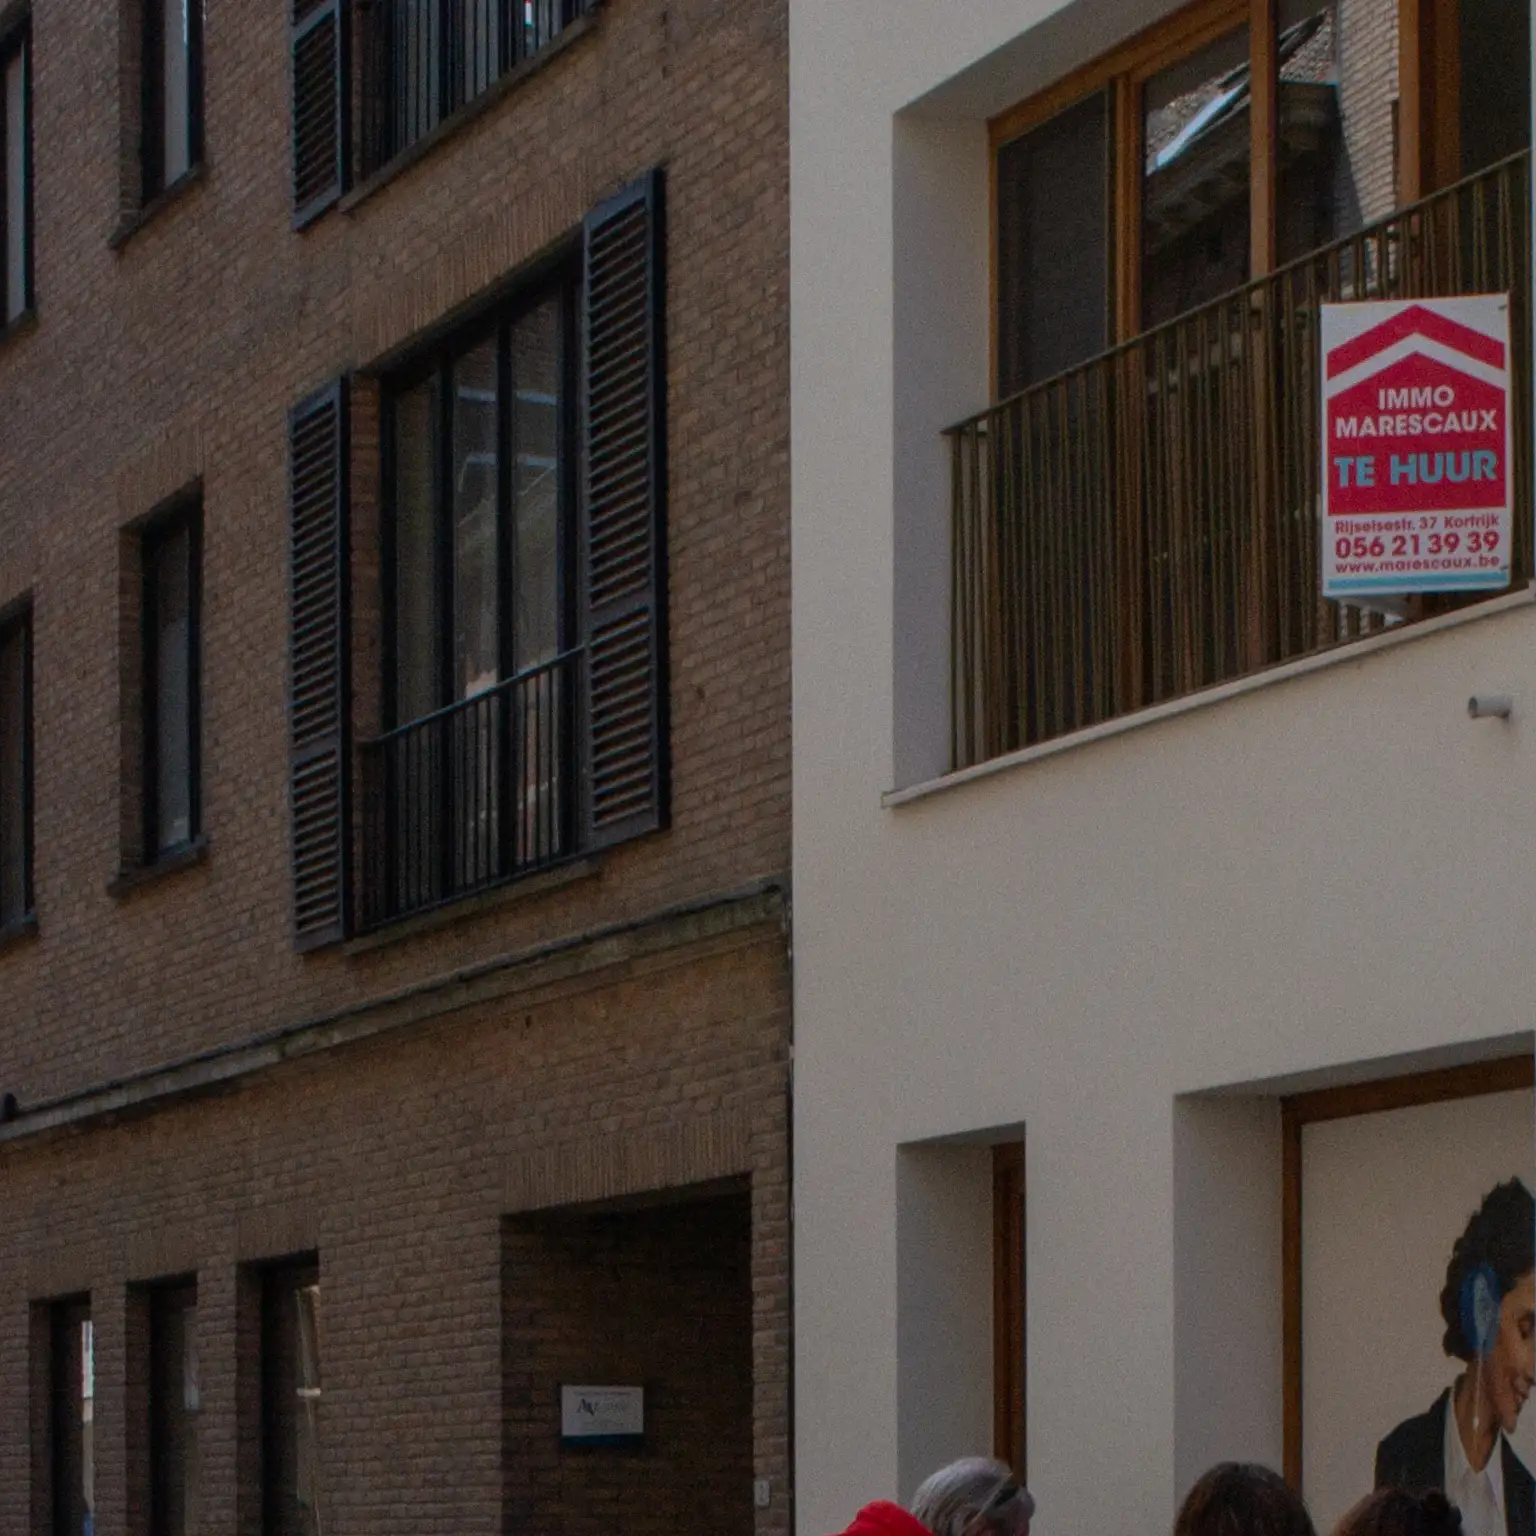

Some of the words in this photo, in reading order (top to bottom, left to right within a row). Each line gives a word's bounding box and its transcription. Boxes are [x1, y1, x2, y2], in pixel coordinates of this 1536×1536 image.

[1379, 385, 1455, 411] IMMO
[1335, 408, 1497, 439] MARESCAUX
[1333, 456, 1376, 488] TE
[1390, 450, 1498, 486] HUUR
[1419, 517, 1438, 530] 37
[1444, 514, 1500, 530] Kortrijk
[1335, 536, 1385, 558] 056
[1392, 534, 1420, 556] 21
[1427, 532, 1460, 554] 39
[1467, 530, 1500, 553] 39
[1335, 554, 1500, 573] www.marescaux.be
